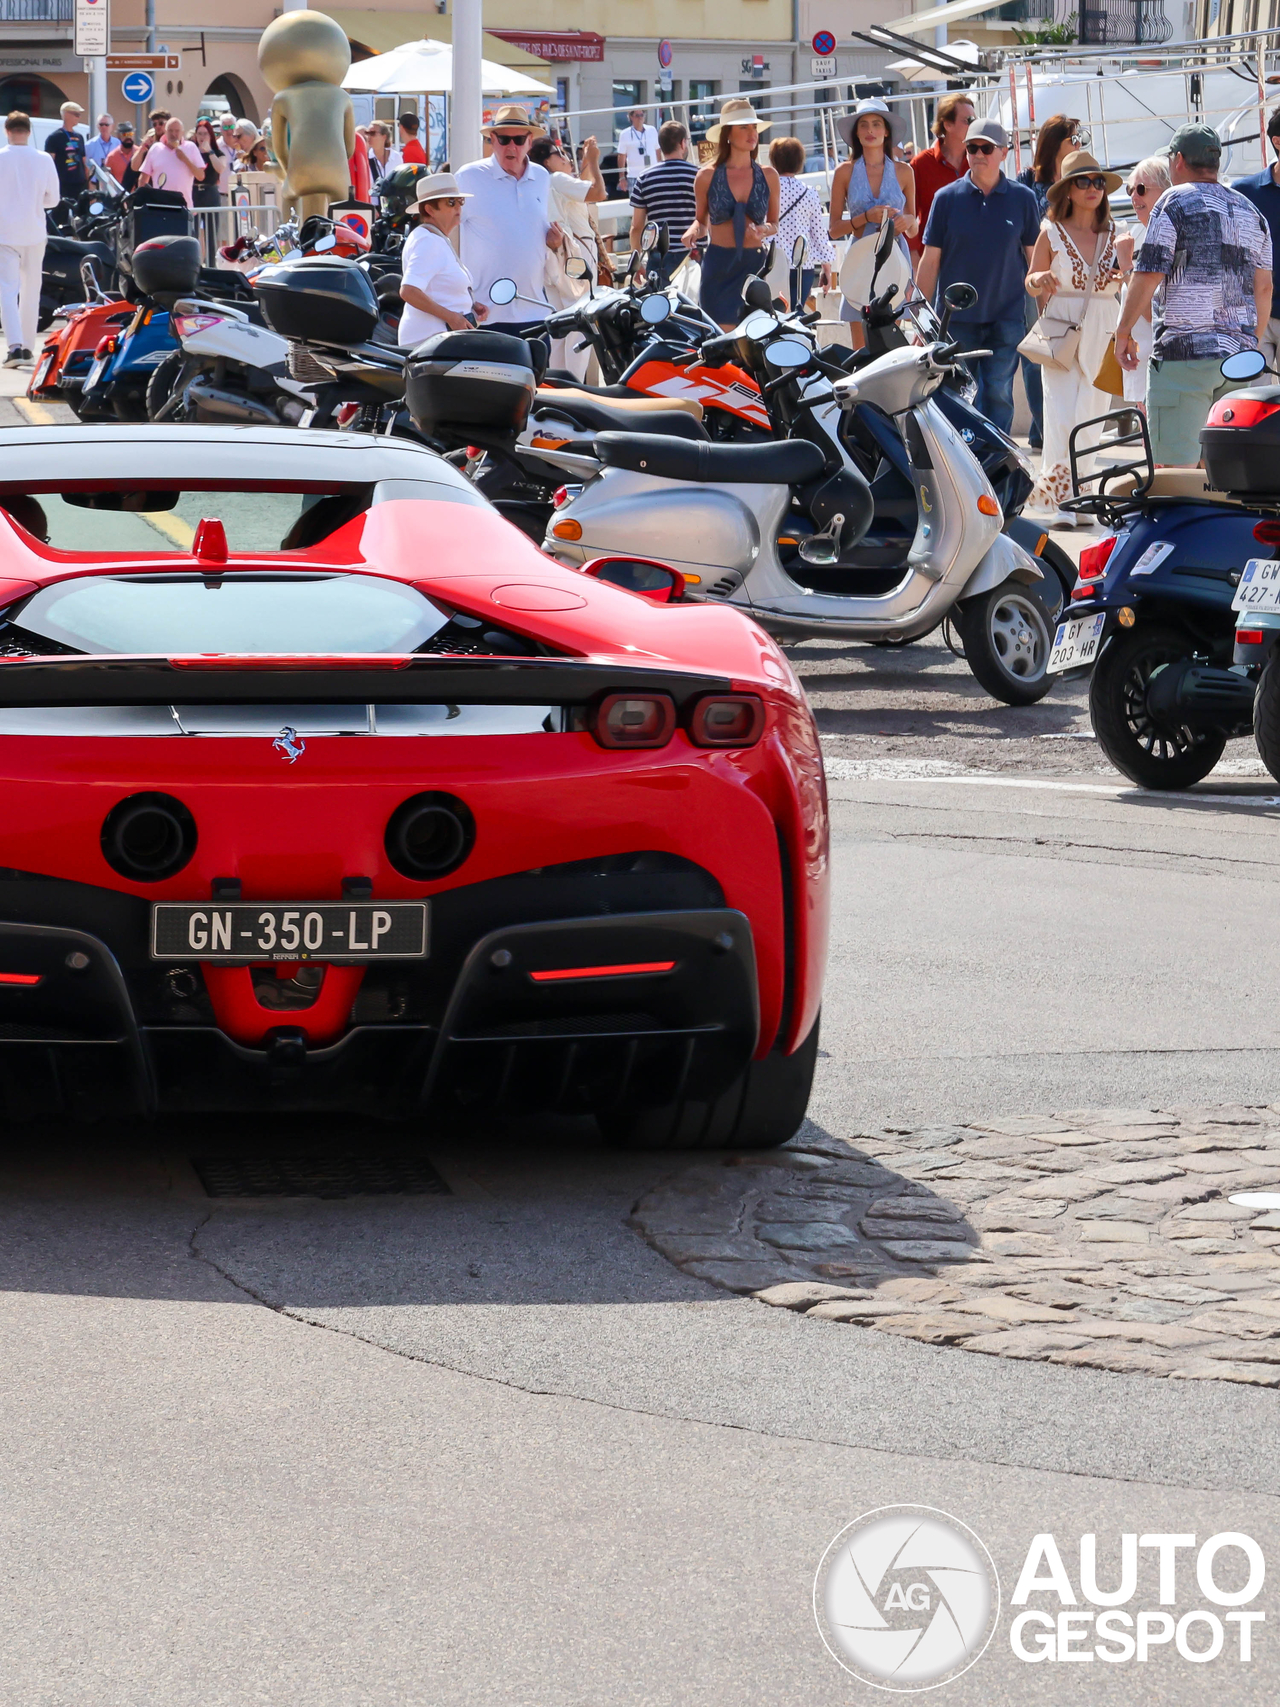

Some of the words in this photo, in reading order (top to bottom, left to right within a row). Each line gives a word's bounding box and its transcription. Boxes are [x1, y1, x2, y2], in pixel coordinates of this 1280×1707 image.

[43, 58, 62, 66] PARIS
[1051, 639, 1096, 666] 203-HR
[188, 911, 393, 950] GN-350-LP
